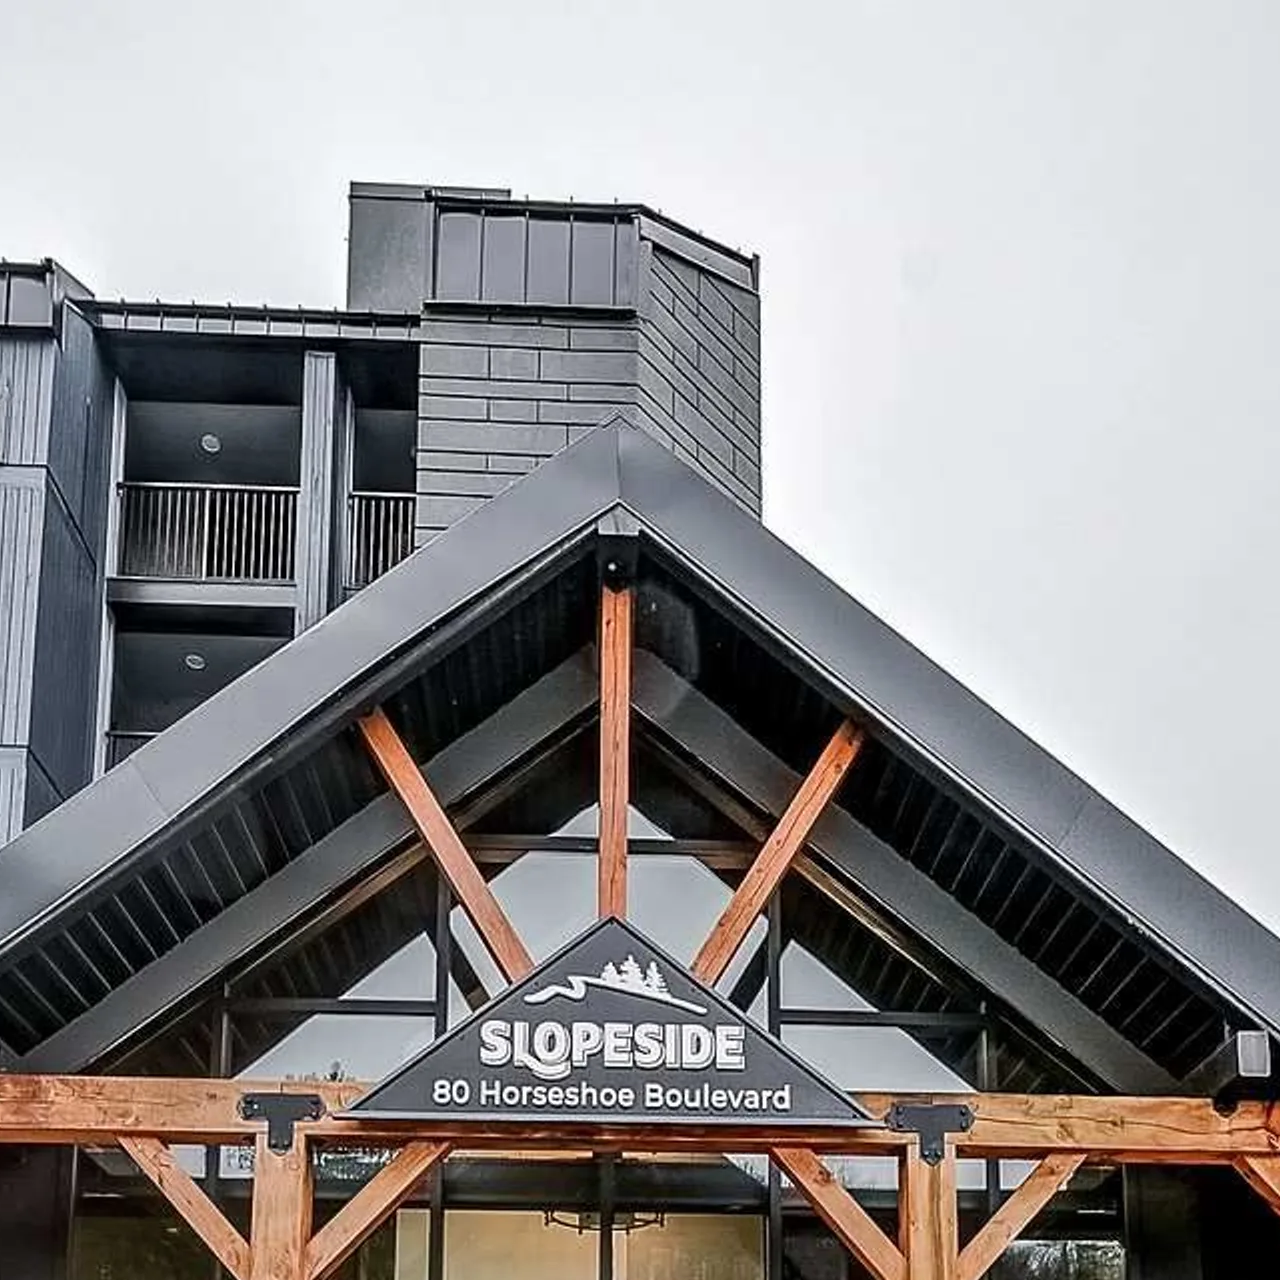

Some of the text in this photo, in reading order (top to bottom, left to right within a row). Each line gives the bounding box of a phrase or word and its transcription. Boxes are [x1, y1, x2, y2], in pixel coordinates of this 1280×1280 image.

[480, 1020, 746, 1080] SLOPESIDE
[433, 1079, 792, 1110] 80 Horseshoe Boulevard
